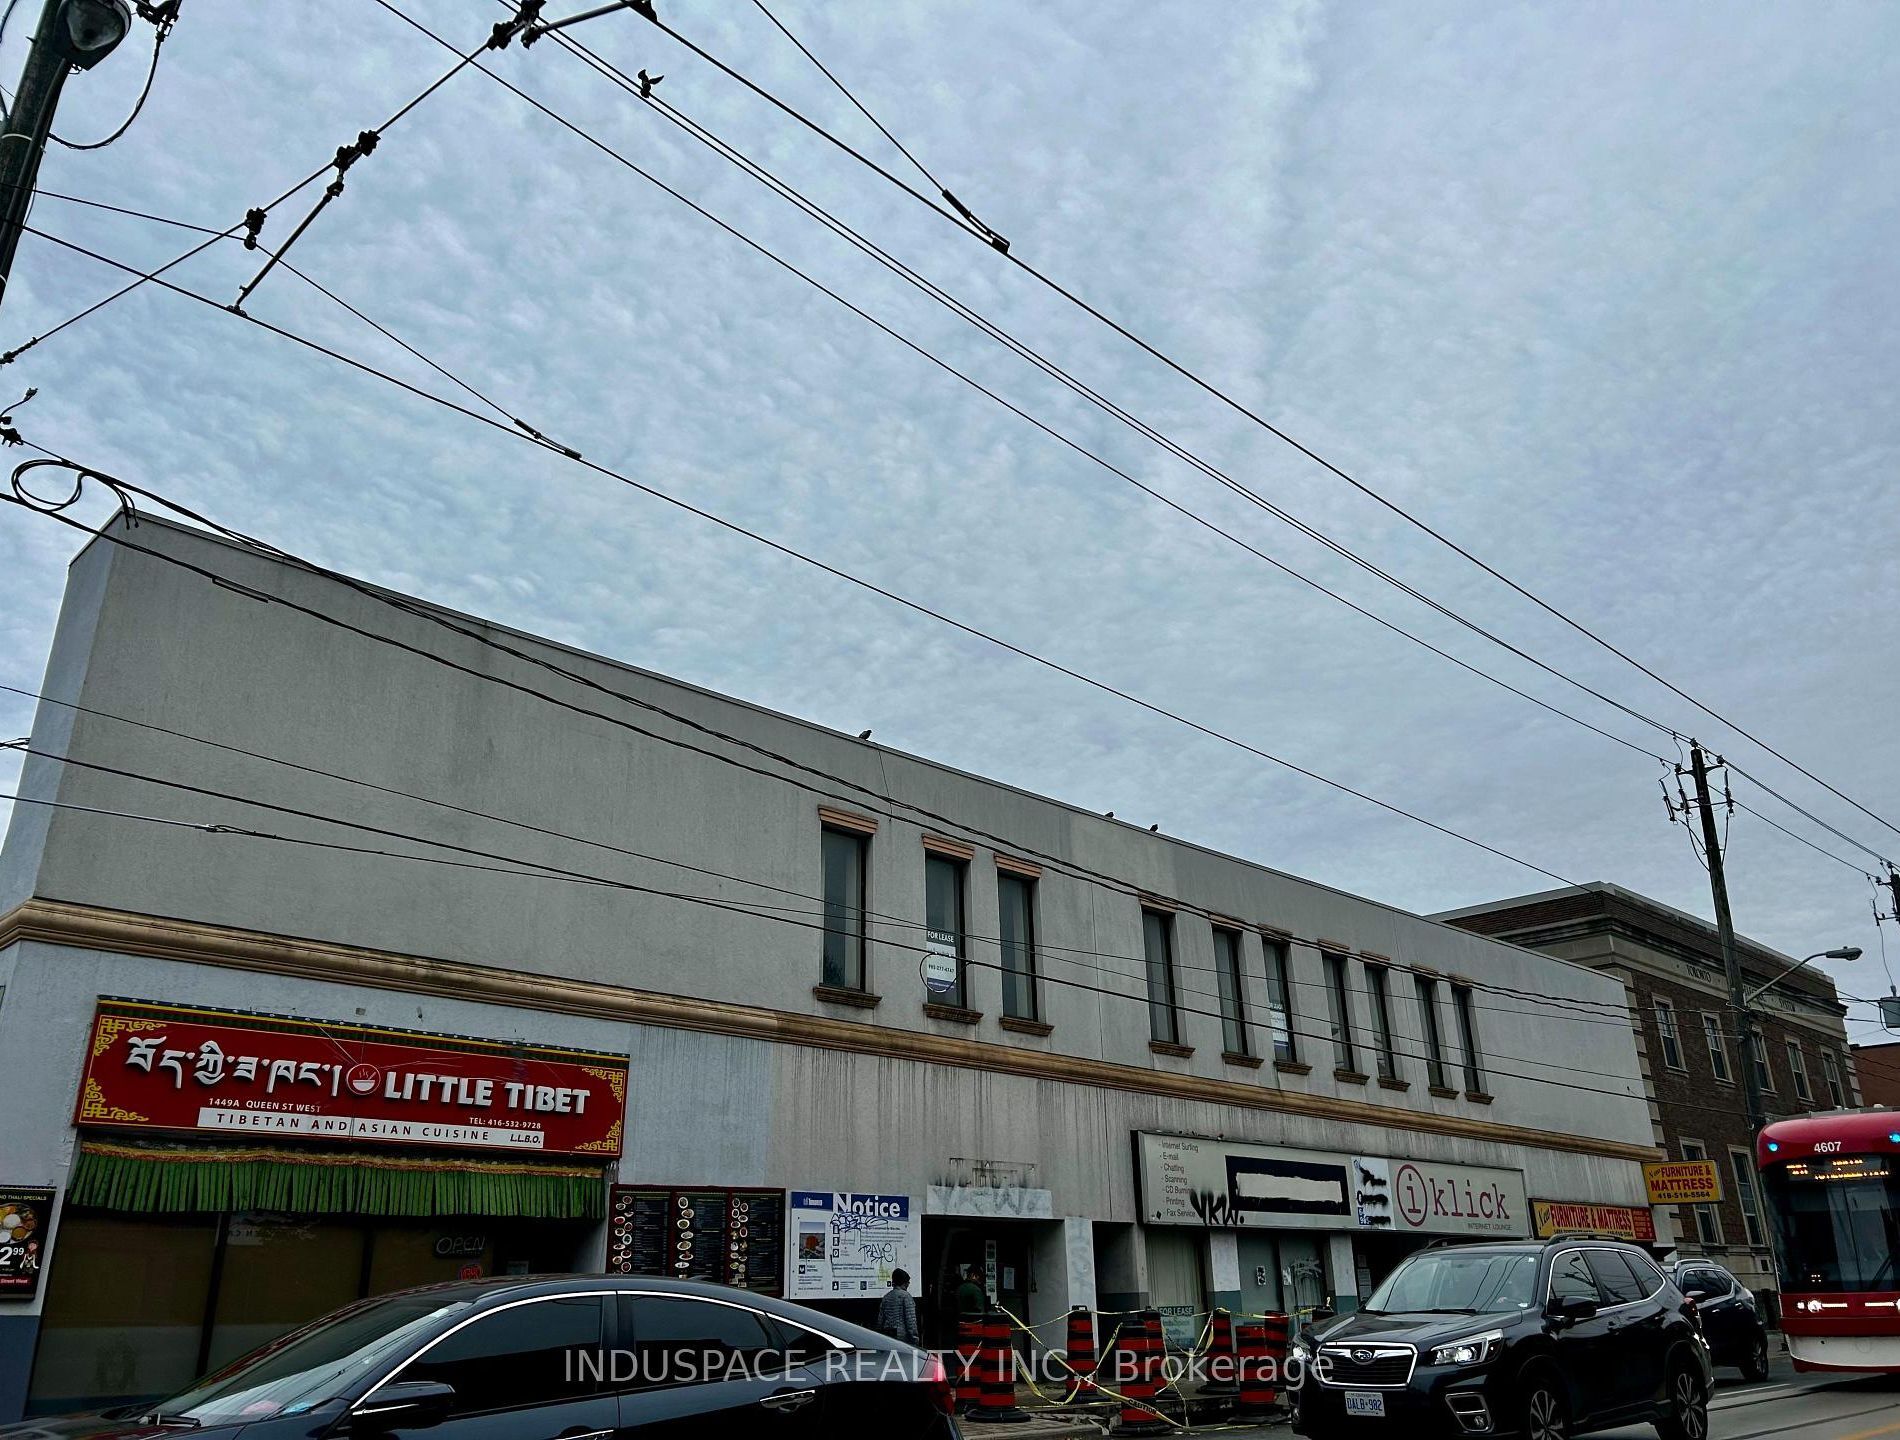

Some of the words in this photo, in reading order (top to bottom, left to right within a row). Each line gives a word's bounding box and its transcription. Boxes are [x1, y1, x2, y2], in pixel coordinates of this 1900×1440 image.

[928, 931, 938, 940] FOR
[939, 933, 955, 943] LEASE
[384, 1071, 493, 1106] LITTLE
[504, 1082, 590, 1113] TIBET
[208, 1098, 240, 1108] 1449A
[246, 1100, 279, 1110] QUEEN
[281, 1103, 293, 1111] ST
[296, 1103, 321, 1113] WEST
[216, 1113, 299, 1128] TIBETAN
[311, 1119, 348, 1131] AND
[358, 1123, 411, 1136] ASIAN
[422, 1127, 489, 1140] CUISINE
[510, 1133, 542, 1144] L.L.B.O.
[469, 1117, 486, 1126] TEL:
[488, 1118, 541, 1129] 416-532-9728
[1161, 1140, 1181, 1150] Internet
[1181, 1143, 1199, 1153] Surfing
[1814, 1141, 1842, 1152] 4607
[1163, 1163, 1185, 1174] Chatting
[1660, 1165, 1704, 1178] FURNITURE
[1705, 1164, 1712, 1176] &
[1164, 1174, 1188, 1185] Scanning
[1650, 1178, 1714, 1192] MATTRESS
[833, 1192, 901, 1218] Notice
[1166, 1208, 1176, 1217] Fax
[1177, 1209, 1196, 1218] Service
[1550, 1203, 1590, 1228] FURNITURE
[1590, 1208, 1598, 1229] &
[1598, 1207, 1633, 1230] MATTRESS
[436, 1235, 486, 1254] OPEN
[1159, 1307, 1173, 1316] FOR
